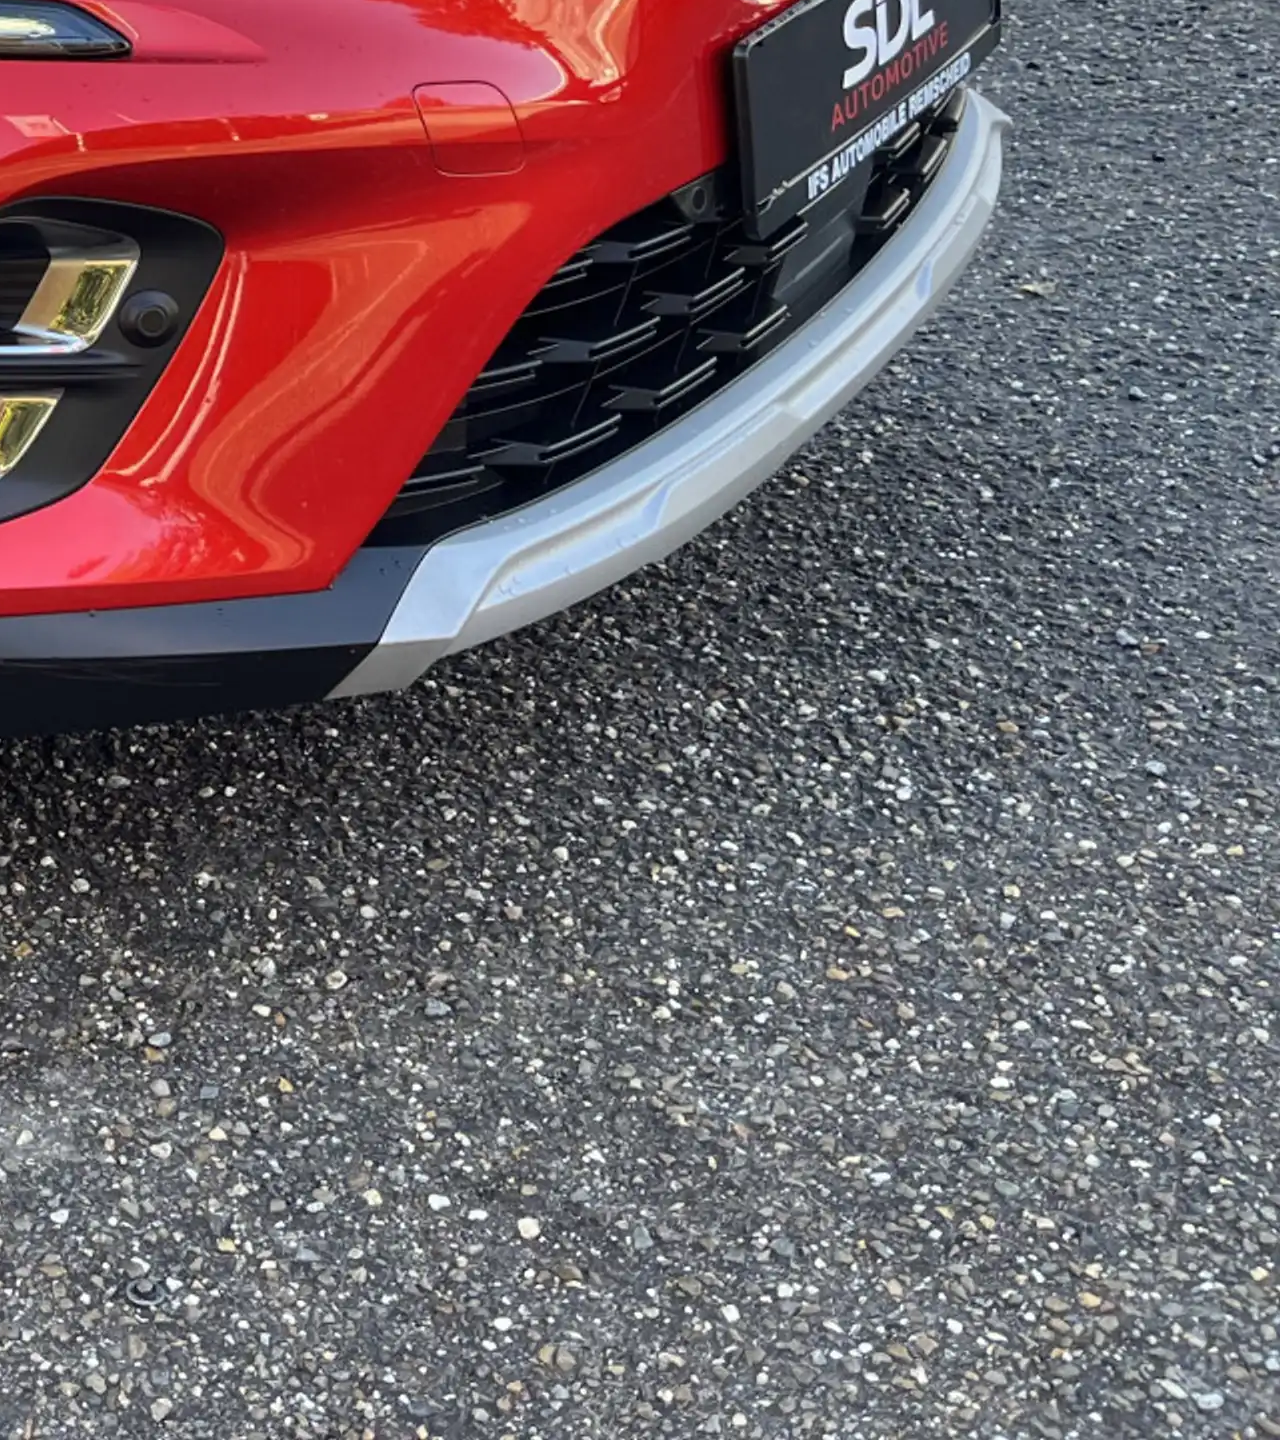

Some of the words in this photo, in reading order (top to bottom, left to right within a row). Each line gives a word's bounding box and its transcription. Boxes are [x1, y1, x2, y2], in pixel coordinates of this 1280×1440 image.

[832, 20, 949, 133] AUTOMOTIVE
[807, 165, 830, 200] IFS
[831, 101, 908, 183] AUTOMOBILE
